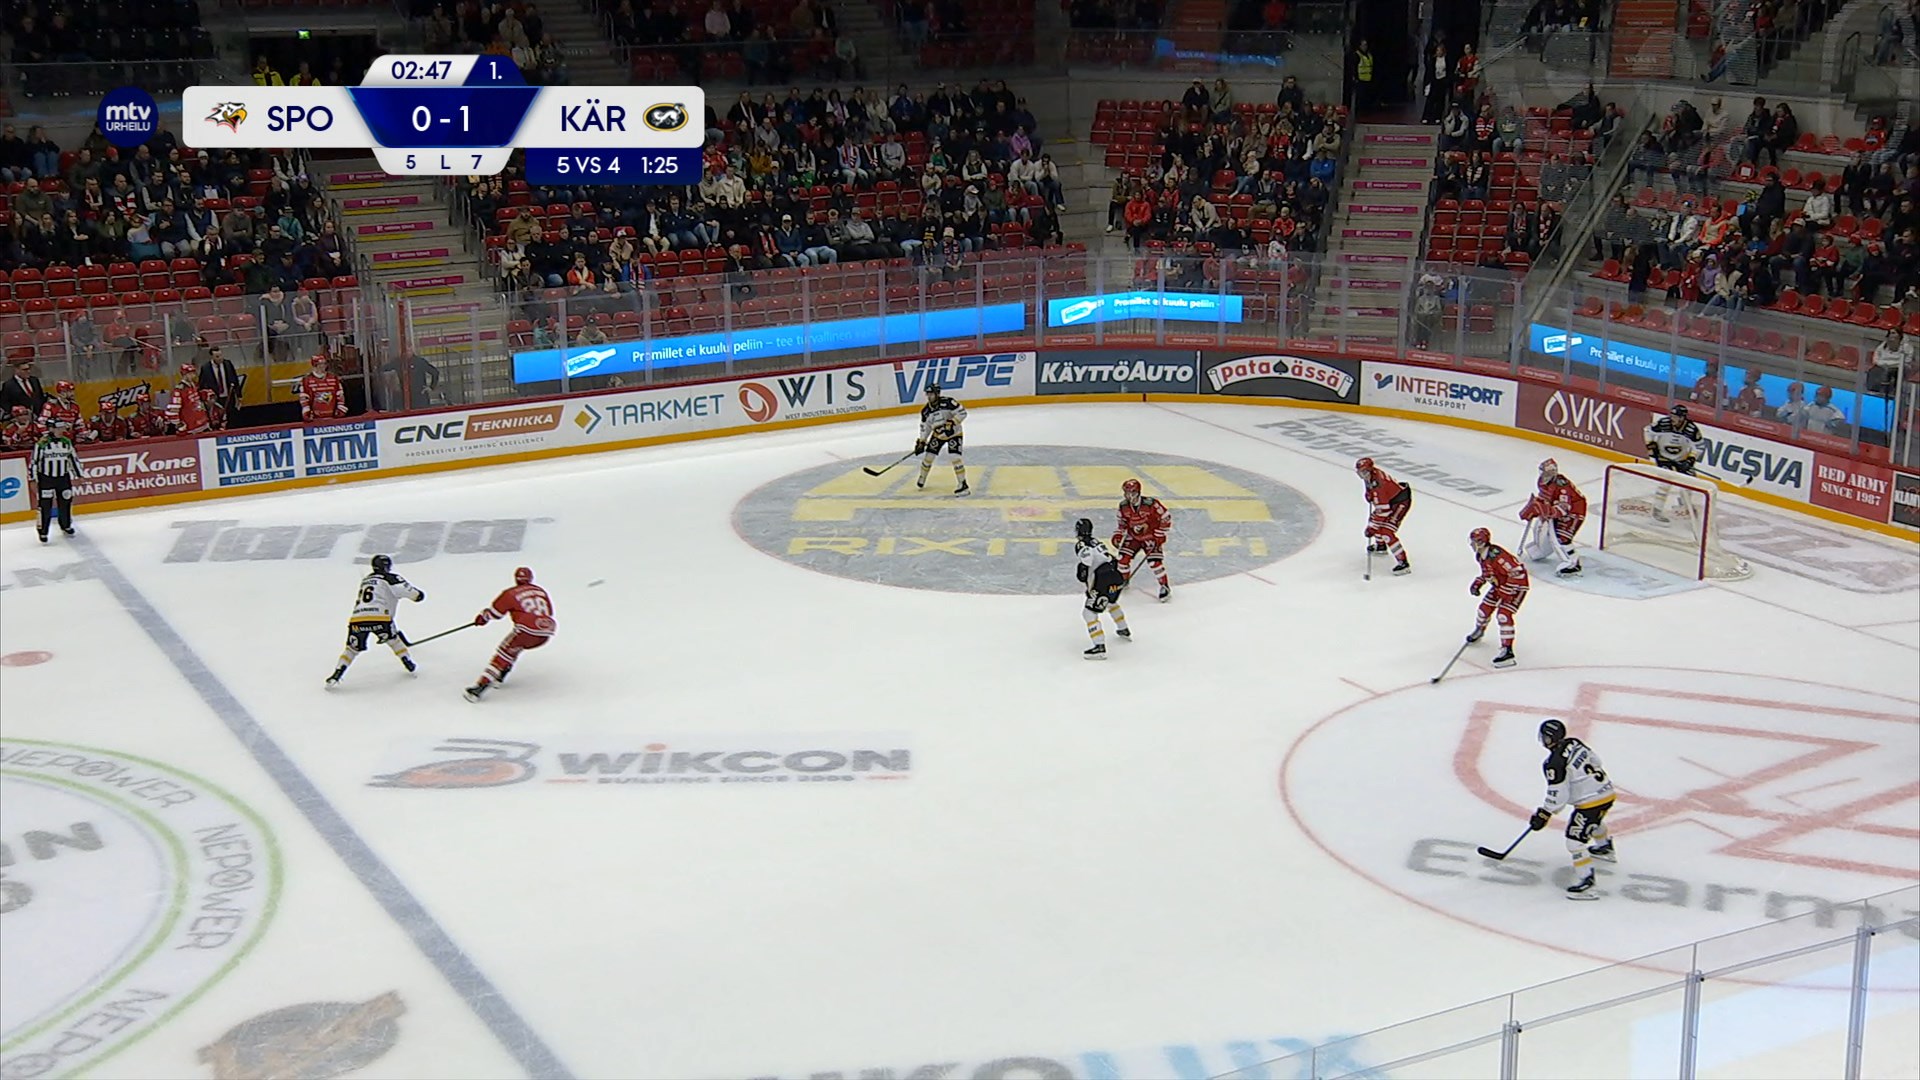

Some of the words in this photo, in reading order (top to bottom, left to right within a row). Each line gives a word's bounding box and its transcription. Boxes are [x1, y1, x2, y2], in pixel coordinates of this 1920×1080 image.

[632, 345, 683, 363] Prmillet
[686, 344, 696, 358] ei
[699, 340, 730, 356] kuulu
[733, 338, 763, 354] peliin
[796, 329, 851, 345] tuvallinen
[1590, 346, 1624, 364] Prillet
[1040, 360, 1194, 384] KÄYTTÖAUTO
[1221, 360, 1271, 383] pata
[1291, 359, 1341, 388] ässä
[777, 370, 866, 409] WIS
[1395, 375, 1504, 407] INTERSPORT
[1414, 396, 1467, 411] WASASPORT
[605, 394, 725, 427] TARKMET
[785, 412, 801, 421] WEST
[801, 408, 835, 419] INDUSTRIAL
[836, 404, 867, 416] SOLUTIONS
[1569, 393, 1627, 441] VKK
[227, 432, 268, 444] RAKENNUS
[269, 431, 281, 441] OY
[314, 423, 354, 435] RAKENNUS
[355, 422, 366, 431] OY
[394, 420, 464, 444] CNC
[471, 413, 554, 433] TEKNIIKKA
[1554, 426, 1615, 448] VKKGROUP.FI
[217, 441, 294, 475] MTM
[303, 432, 378, 465] MTM
[405, 447, 457, 458] PROGRESSIVE
[460, 442, 497, 452] STAMPING
[499, 436, 545, 448] EXCELLENCE
[1254, 420, 1503, 497] Pohjalainen
[72, 463, 123, 480] kon
[125, 451, 197, 474] Kone
[231, 472, 272, 484] BYGGNADS
[273, 471, 285, 480] AB
[316, 463, 357, 474] BYGGNADS
[358, 461, 369, 470] AB
[1696, 438, 1803, 489] NGSVA
[71, 482, 114, 498] MÄEN
[117, 472, 198, 492] SÄHKÖLIIKE
[1818, 465, 1846, 484] RED
[1847, 473, 1888, 494] ARMY
[1821, 481, 1853, 499] SINCE
[1856, 491, 1881, 506] 1987
[163, 519, 526, 564] Targa
